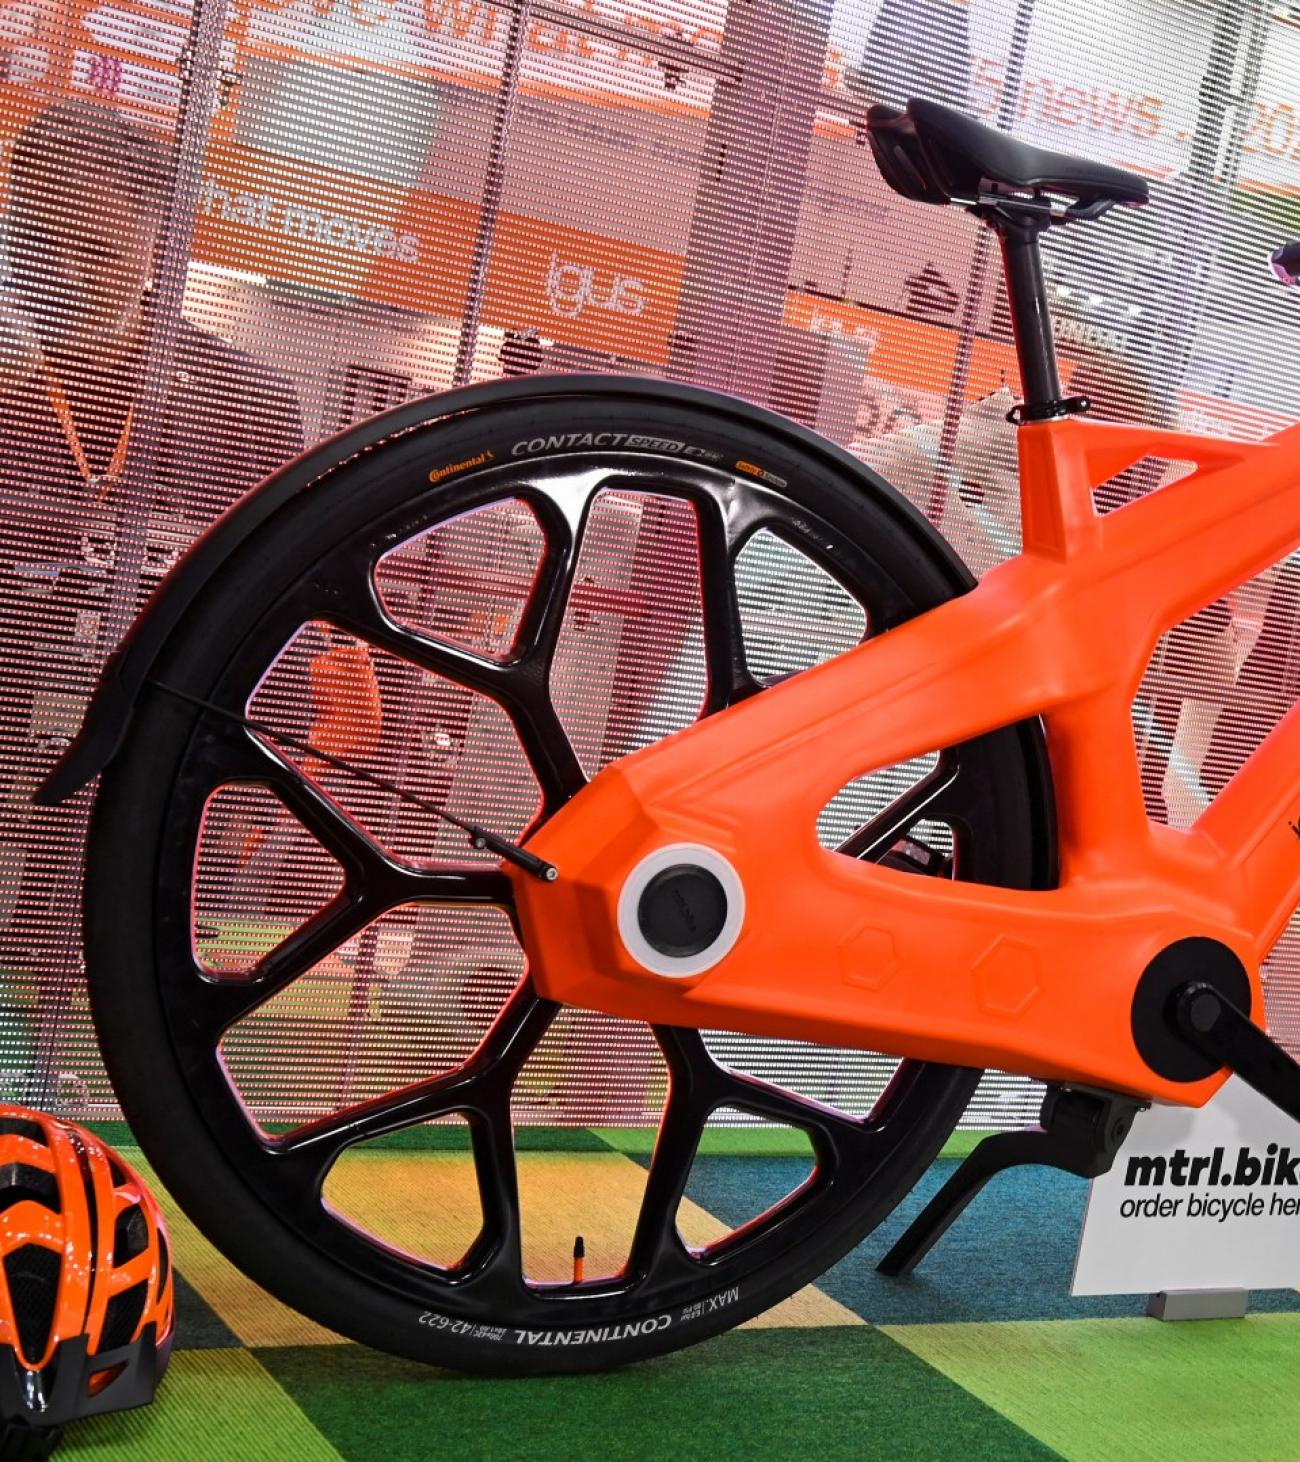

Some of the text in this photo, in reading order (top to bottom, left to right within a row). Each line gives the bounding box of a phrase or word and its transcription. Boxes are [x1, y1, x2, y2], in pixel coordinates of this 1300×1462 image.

[200, 178, 421, 264] hat moves
[547, 250, 645, 318] igus
[428, 455, 486, 484] Continental
[511, 432, 633, 457] CONTACT
[627, 433, 684, 453] SPEED
[1119, 1193, 1183, 1218] order
[1186, 1191, 1265, 1223] bicycle
[417, 1310, 470, 1335] 42-622
[514, 1314, 672, 1346] CONTINENTAL
